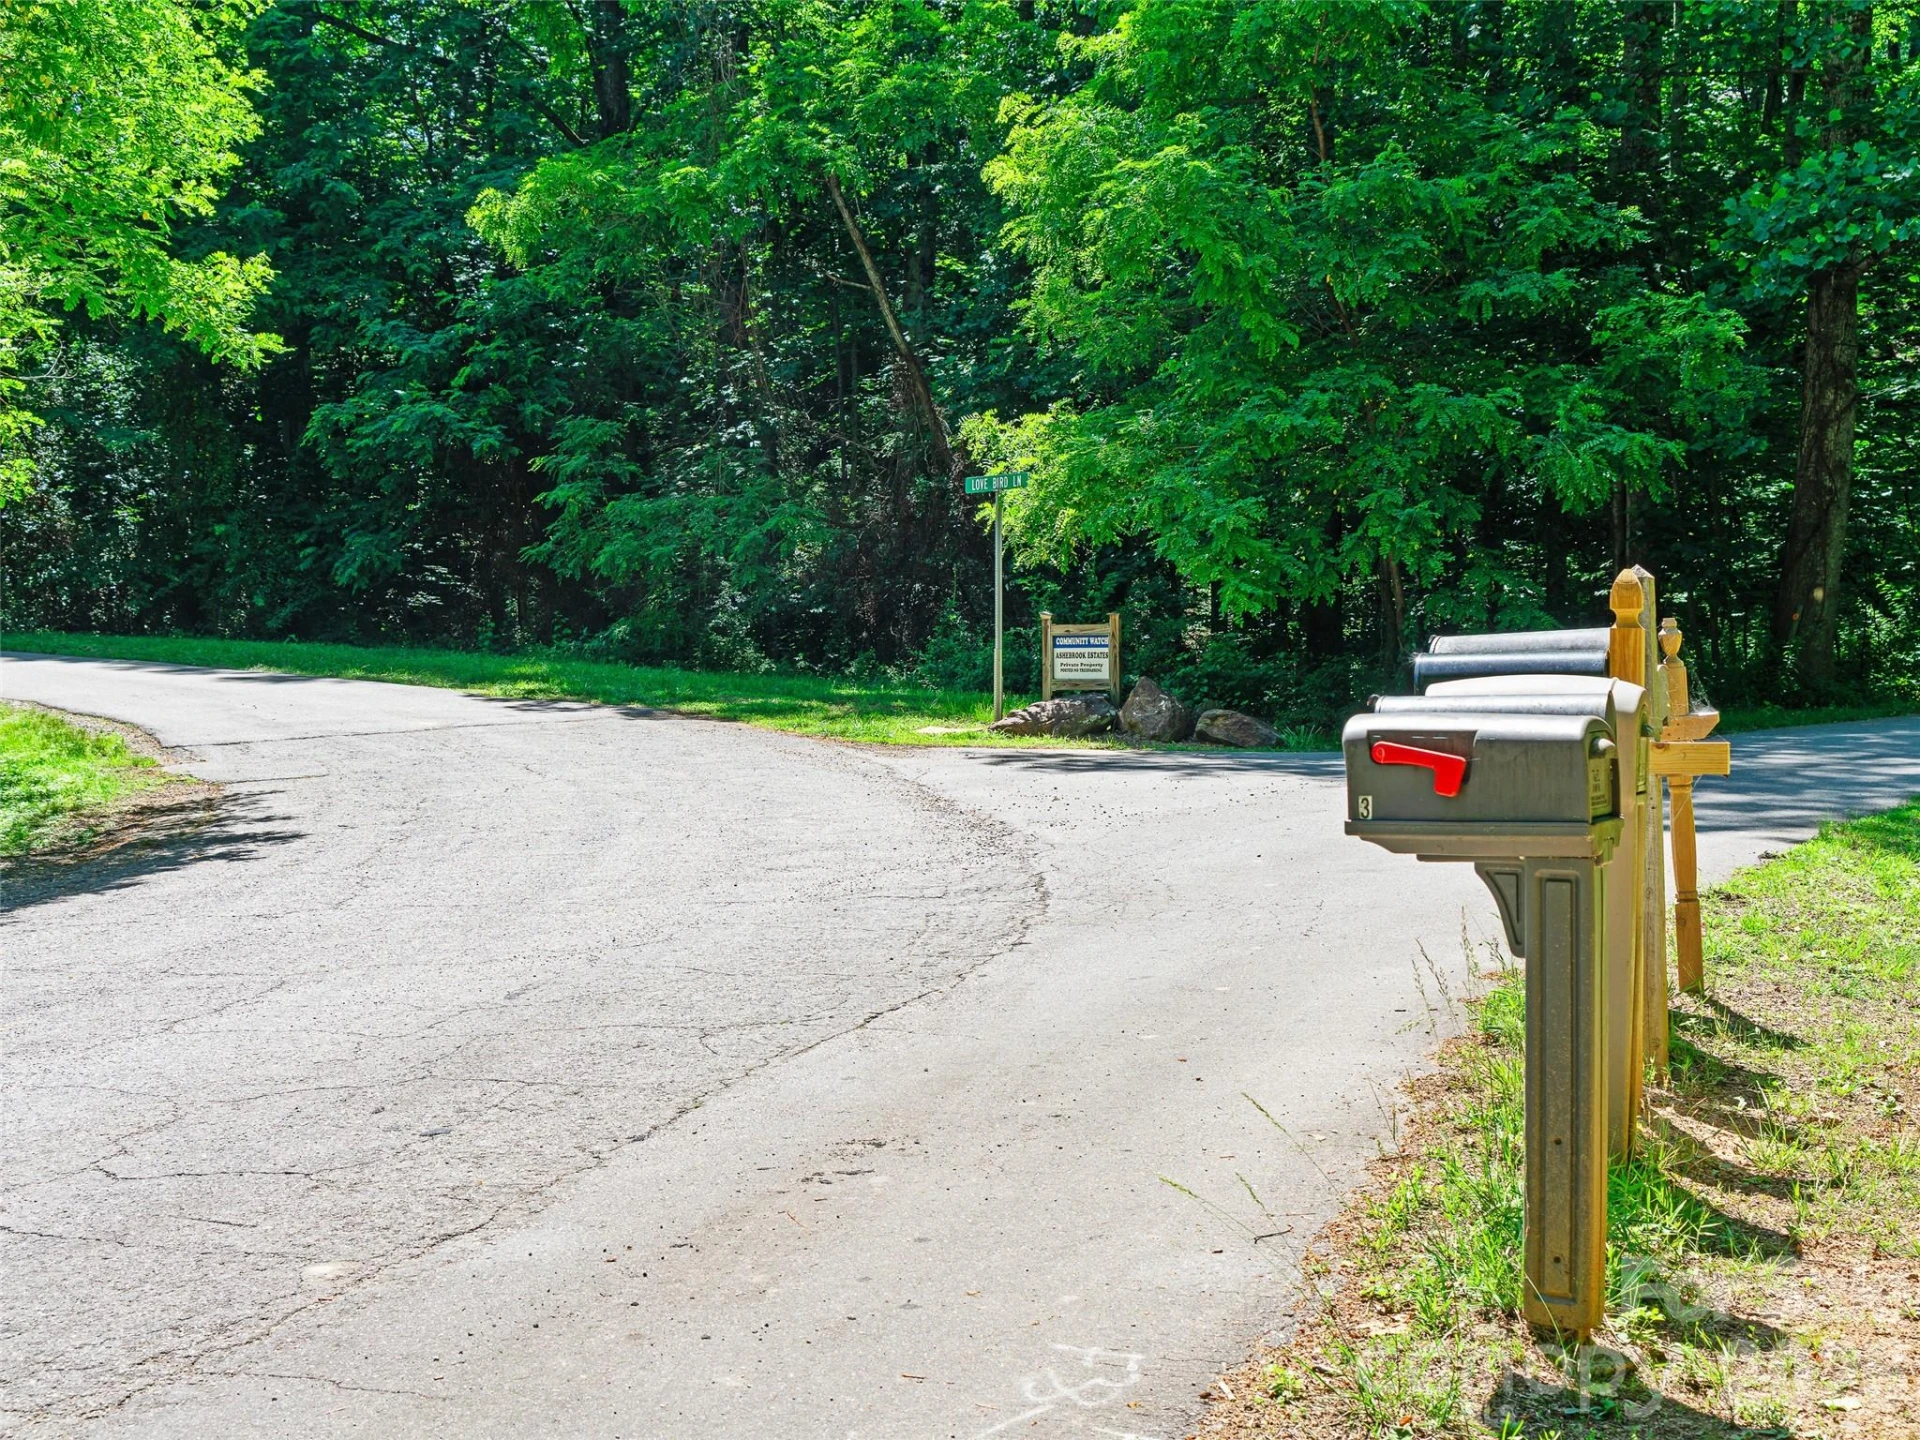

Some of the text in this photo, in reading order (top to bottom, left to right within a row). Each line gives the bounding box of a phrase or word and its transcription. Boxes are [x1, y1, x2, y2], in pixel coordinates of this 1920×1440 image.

[972, 476, 1022, 490] LOVE BIRD LN
[1056, 637, 1108, 645] COMMUNITY WATCH
[1360, 798, 1370, 818] 3
